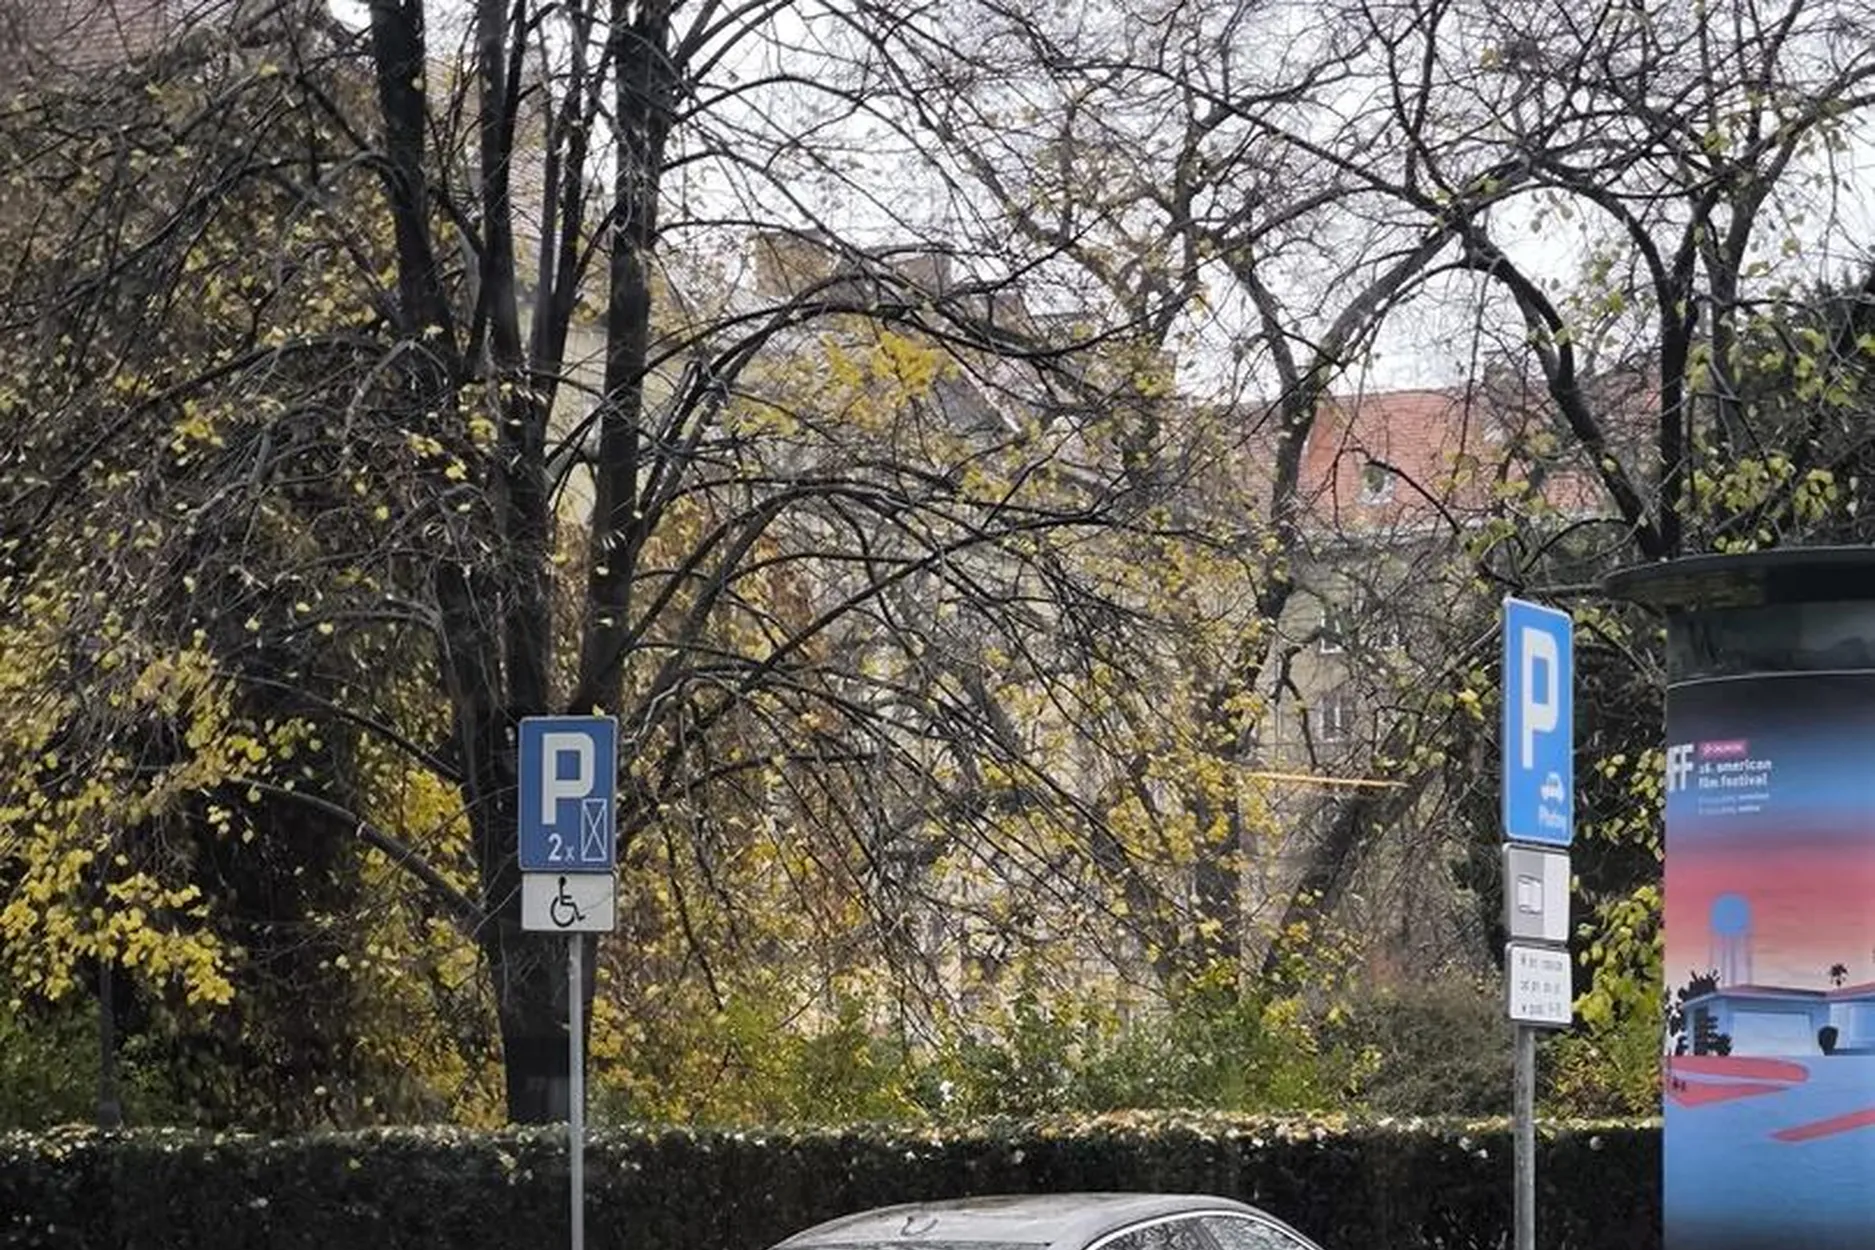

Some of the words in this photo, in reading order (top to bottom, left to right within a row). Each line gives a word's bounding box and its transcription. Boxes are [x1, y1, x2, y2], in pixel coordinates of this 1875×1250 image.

[1522, 627, 1559, 770] P
[541, 732, 595, 825] P
[1717, 758, 1772, 774] american
[1721, 771, 1768, 788] festival
